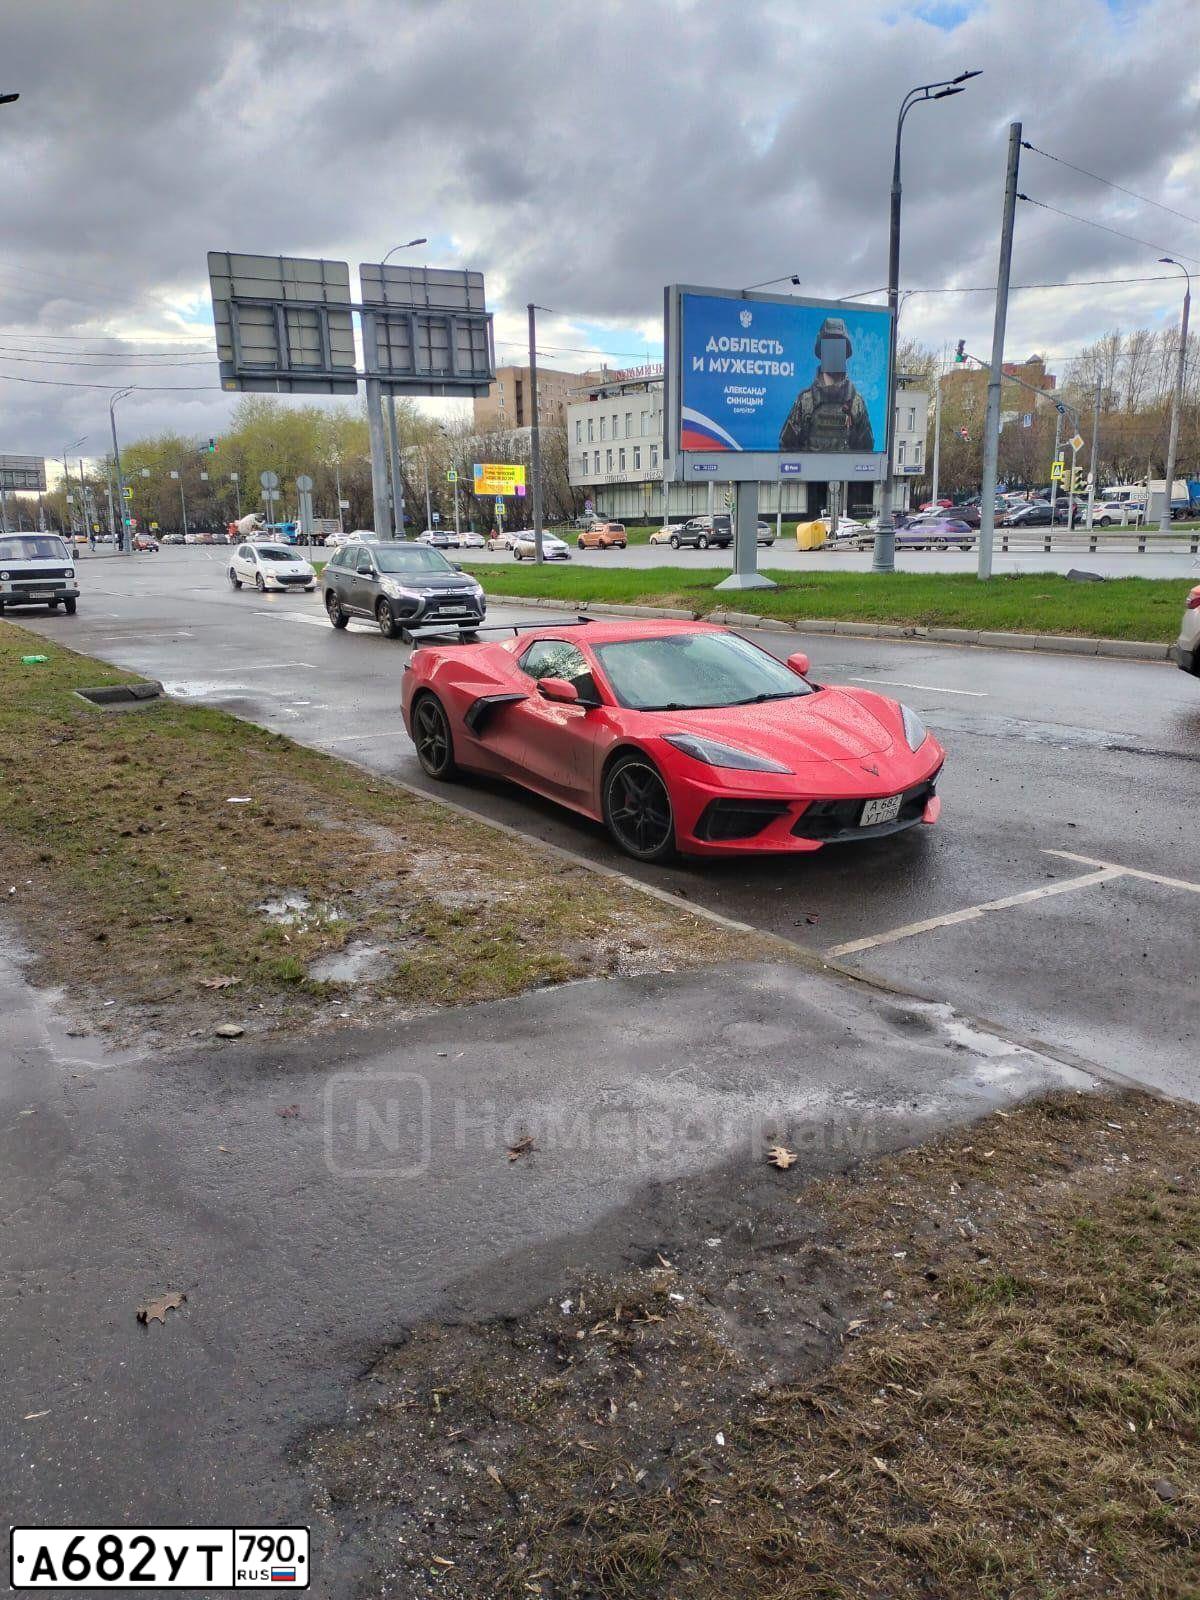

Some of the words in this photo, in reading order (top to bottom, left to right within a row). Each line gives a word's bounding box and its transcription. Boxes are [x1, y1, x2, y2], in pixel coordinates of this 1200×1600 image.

[705, 335, 784, 355] ДОБЛЕСТЬ
[692, 356, 704, 372] И
[708, 357, 795, 377] МУЖЕСТВО!
[723, 385, 767, 396] АЛЕКСАНДР
